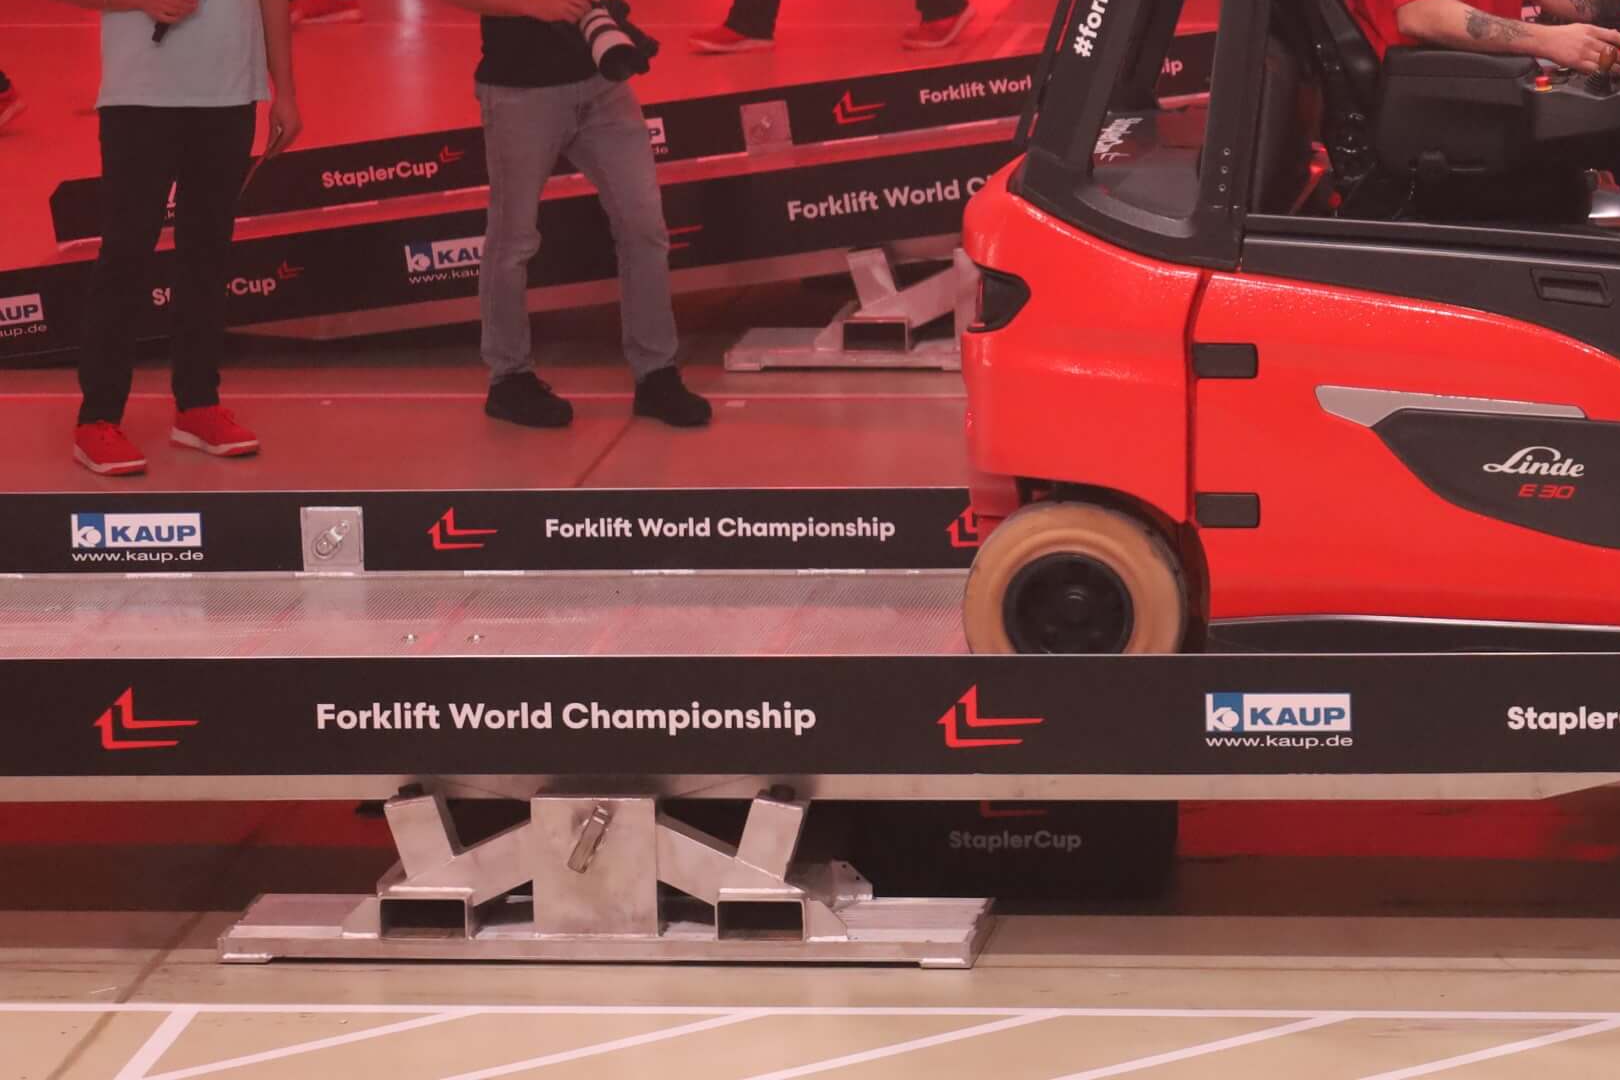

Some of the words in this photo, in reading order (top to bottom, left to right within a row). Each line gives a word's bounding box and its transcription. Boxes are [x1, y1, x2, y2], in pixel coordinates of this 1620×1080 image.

[919, 83, 986, 104] Forklift
[989, 75, 1032, 95] Worl
[322, 161, 438, 188] StaplerCup
[787, 190, 879, 221] Forklift
[883, 179, 960, 207] World
[408, 268, 481, 284] www.kau
[1483, 446, 1585, 478] Linde
[1518, 483, 1537, 499] E
[1538, 483, 1575, 500] 30
[111, 525, 197, 542] KAUP
[545, 519, 633, 538] Forklift
[638, 518, 711, 537] World
[717, 517, 896, 542] Championship
[71, 550, 204, 563] www.kaup.de
[316, 703, 440, 730] Forklift
[449, 703, 552, 730] World
[562, 701, 817, 737] Championship
[1249, 707, 1346, 726] KAUP
[1205, 735, 1354, 749] www.kaup.de
[948, 830, 1082, 853] StaplerCup
